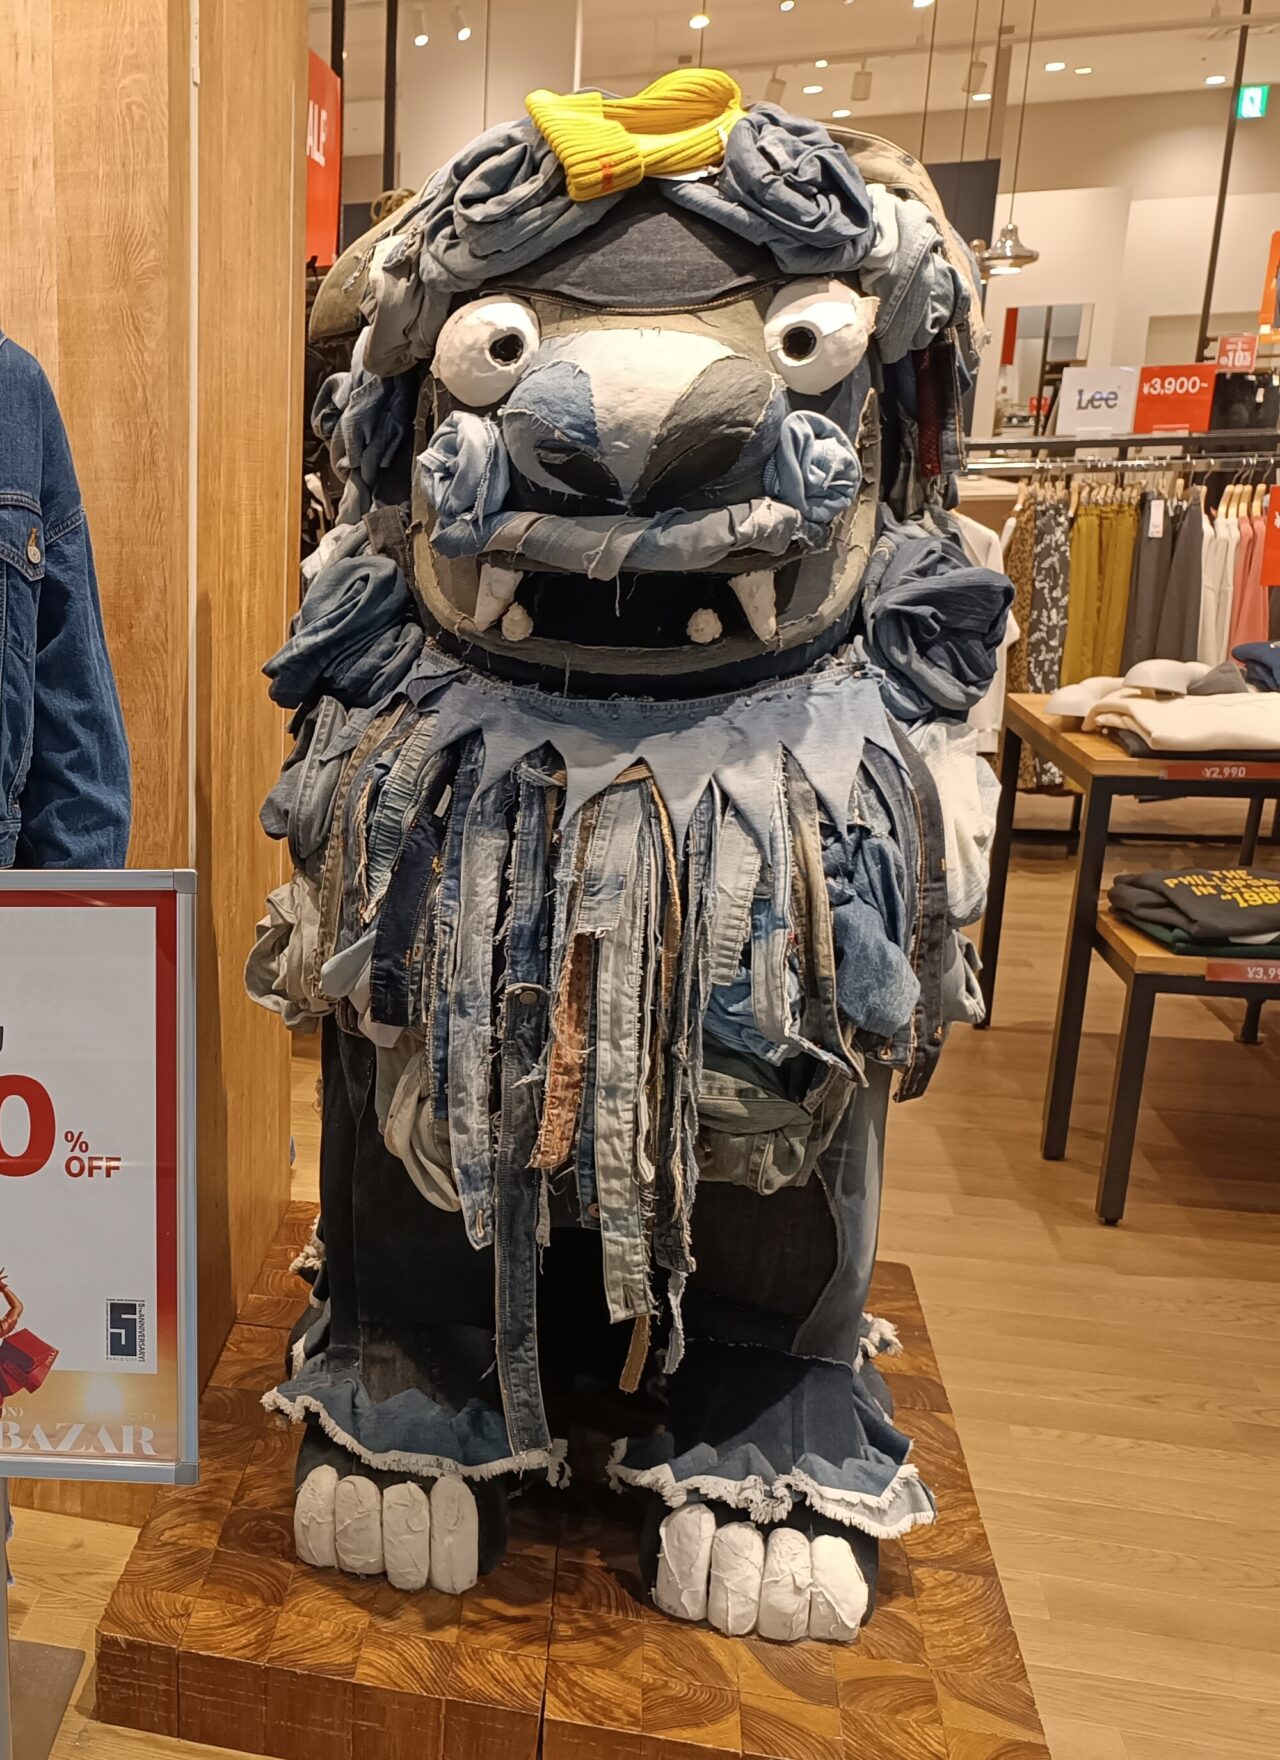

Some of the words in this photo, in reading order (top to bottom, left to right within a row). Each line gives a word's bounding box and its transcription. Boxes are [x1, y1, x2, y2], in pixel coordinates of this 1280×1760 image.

[306, 100, 328, 168] ALE
[1076, 388, 1118, 411] Lee
[64, 1155, 122, 1179] OFF
